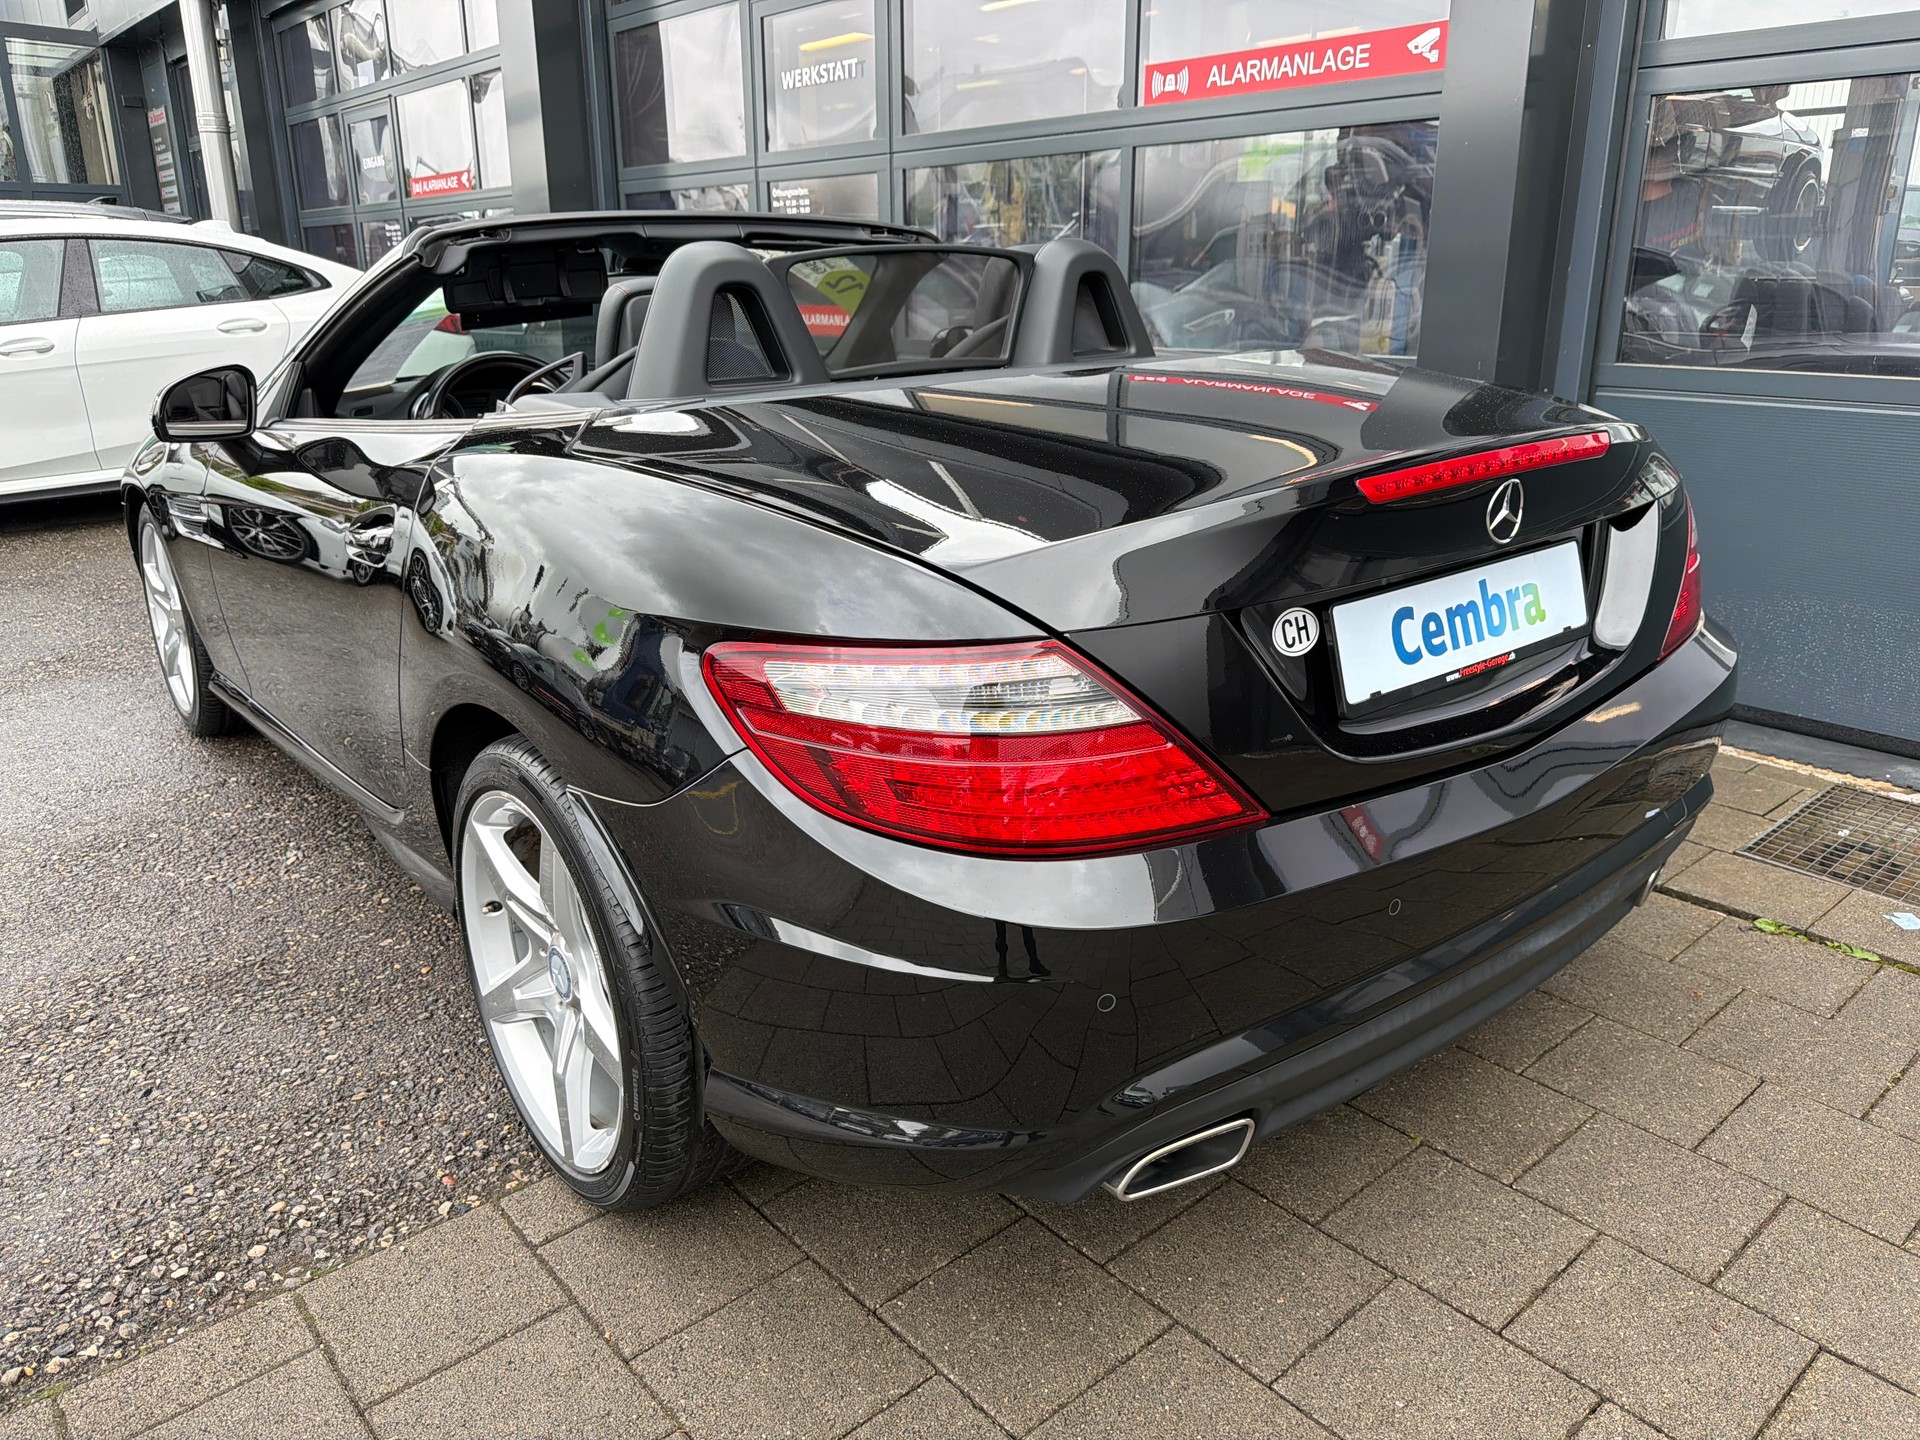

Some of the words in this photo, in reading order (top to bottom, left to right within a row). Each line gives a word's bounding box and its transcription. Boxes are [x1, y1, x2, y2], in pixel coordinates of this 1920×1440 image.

[781, 57, 858, 90] WERKSTATT
[1206, 43, 1371, 89] ALARMANLAGE
[422, 175, 459, 193] ALARMANLAGE
[1281, 614, 1311, 649] CH
[1391, 578, 1546, 666] Cembra
[1445, 651, 1516, 683] www.Freestyle-Garage.ch
